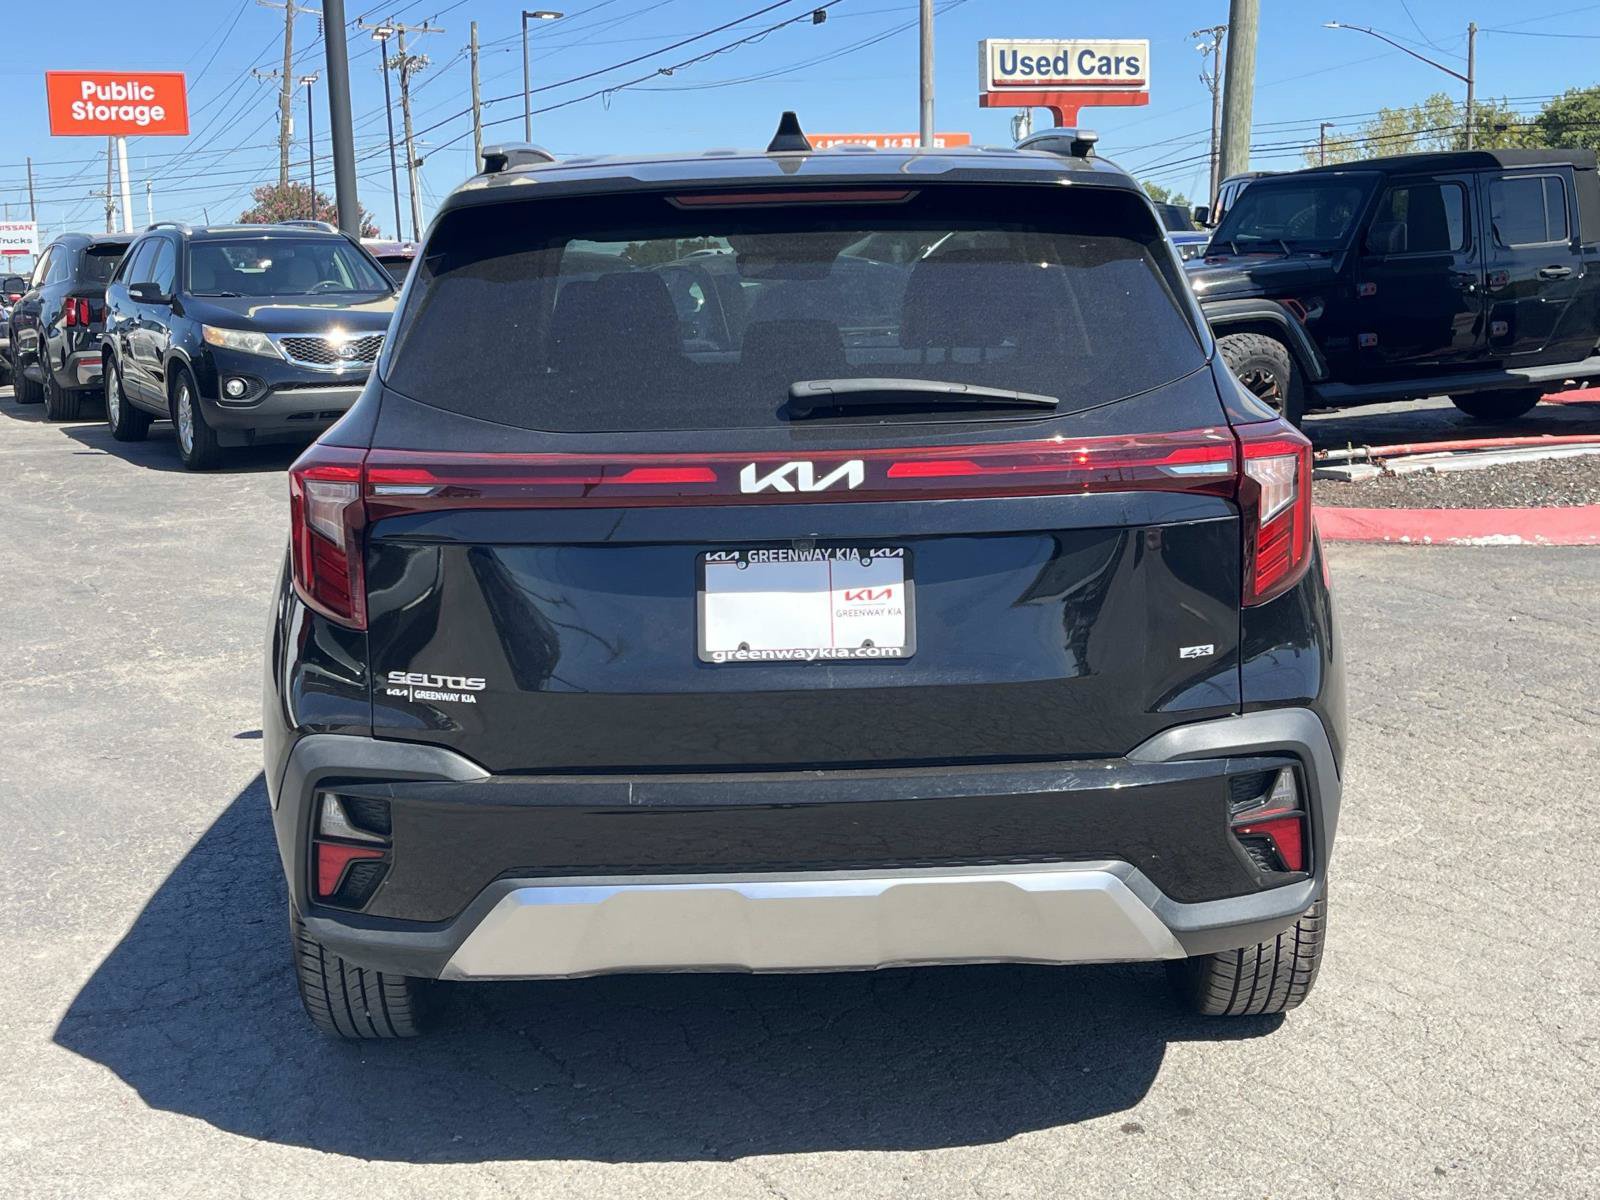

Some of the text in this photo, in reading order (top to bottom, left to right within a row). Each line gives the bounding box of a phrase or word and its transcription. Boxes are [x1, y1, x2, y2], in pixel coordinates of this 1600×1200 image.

[1000, 49, 1140, 75] Used Cars
[81, 81, 155, 101] Public
[71, 101, 165, 126] Storage
[740, 460, 864, 493] KIA
[705, 547, 904, 563] KIA GREENWAY KIA KIA
[845, 588, 892, 601] KIA
[835, 607, 903, 618] GREENWAY KIA
[712, 647, 901, 663] greenwaykia.com
[387, 670, 486, 691] SELTOS
[414, 689, 460, 702] GREENWAY
[461, 693, 477, 704] KIA
